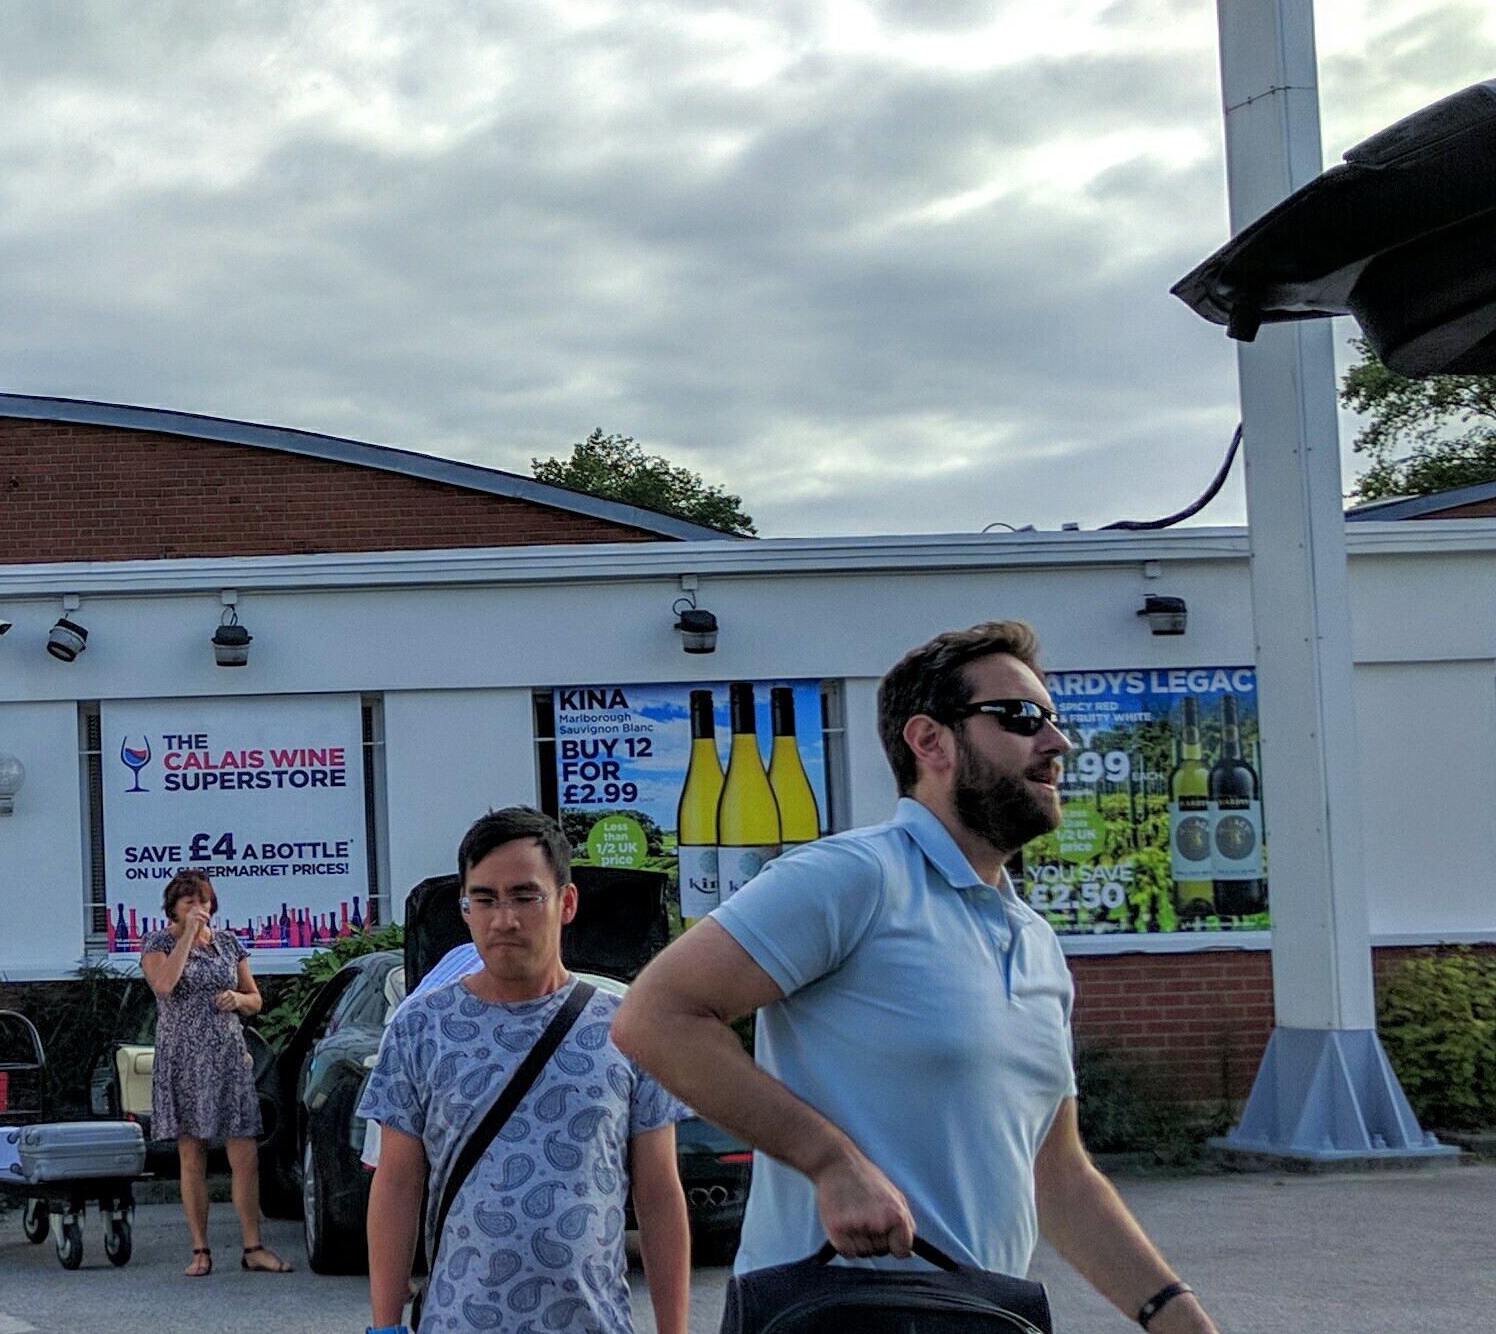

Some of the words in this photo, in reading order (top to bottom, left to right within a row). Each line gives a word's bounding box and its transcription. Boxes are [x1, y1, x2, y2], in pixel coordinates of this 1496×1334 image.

[1046, 671, 1145, 695] ARDYS
[1150, 669, 1256, 693] LEGAC
[559, 688, 629, 711] KINA
[559, 713, 631, 724] Marlborough
[559, 724, 619, 736] Sauvignon
[622, 723, 653, 733] Blanc
[163, 734, 208, 750] THE
[562, 738, 619, 760] BUY
[625, 737, 653, 758] 12
[164, 750, 264, 771] CALAIS
[269, 748, 346, 768] WINE
[1057, 750, 1130, 783] .99
[164, 769, 346, 791] SUPERSTORE
[562, 761, 620, 782] FOR
[563, 783, 638, 805] £2.99
[124, 846, 181, 863] SAVE
[189, 833, 237, 861] £4
[242, 844, 258, 860] A
[618, 842, 638, 853] UK
[125, 867, 148, 880] ON
[152, 867, 173, 879] UK
[292, 863, 349, 876] PRICES!
[1028, 865, 1075, 883] YOU
[1079, 863, 1134, 883] SAVE
[1030, 882, 1125, 909] £2.50
